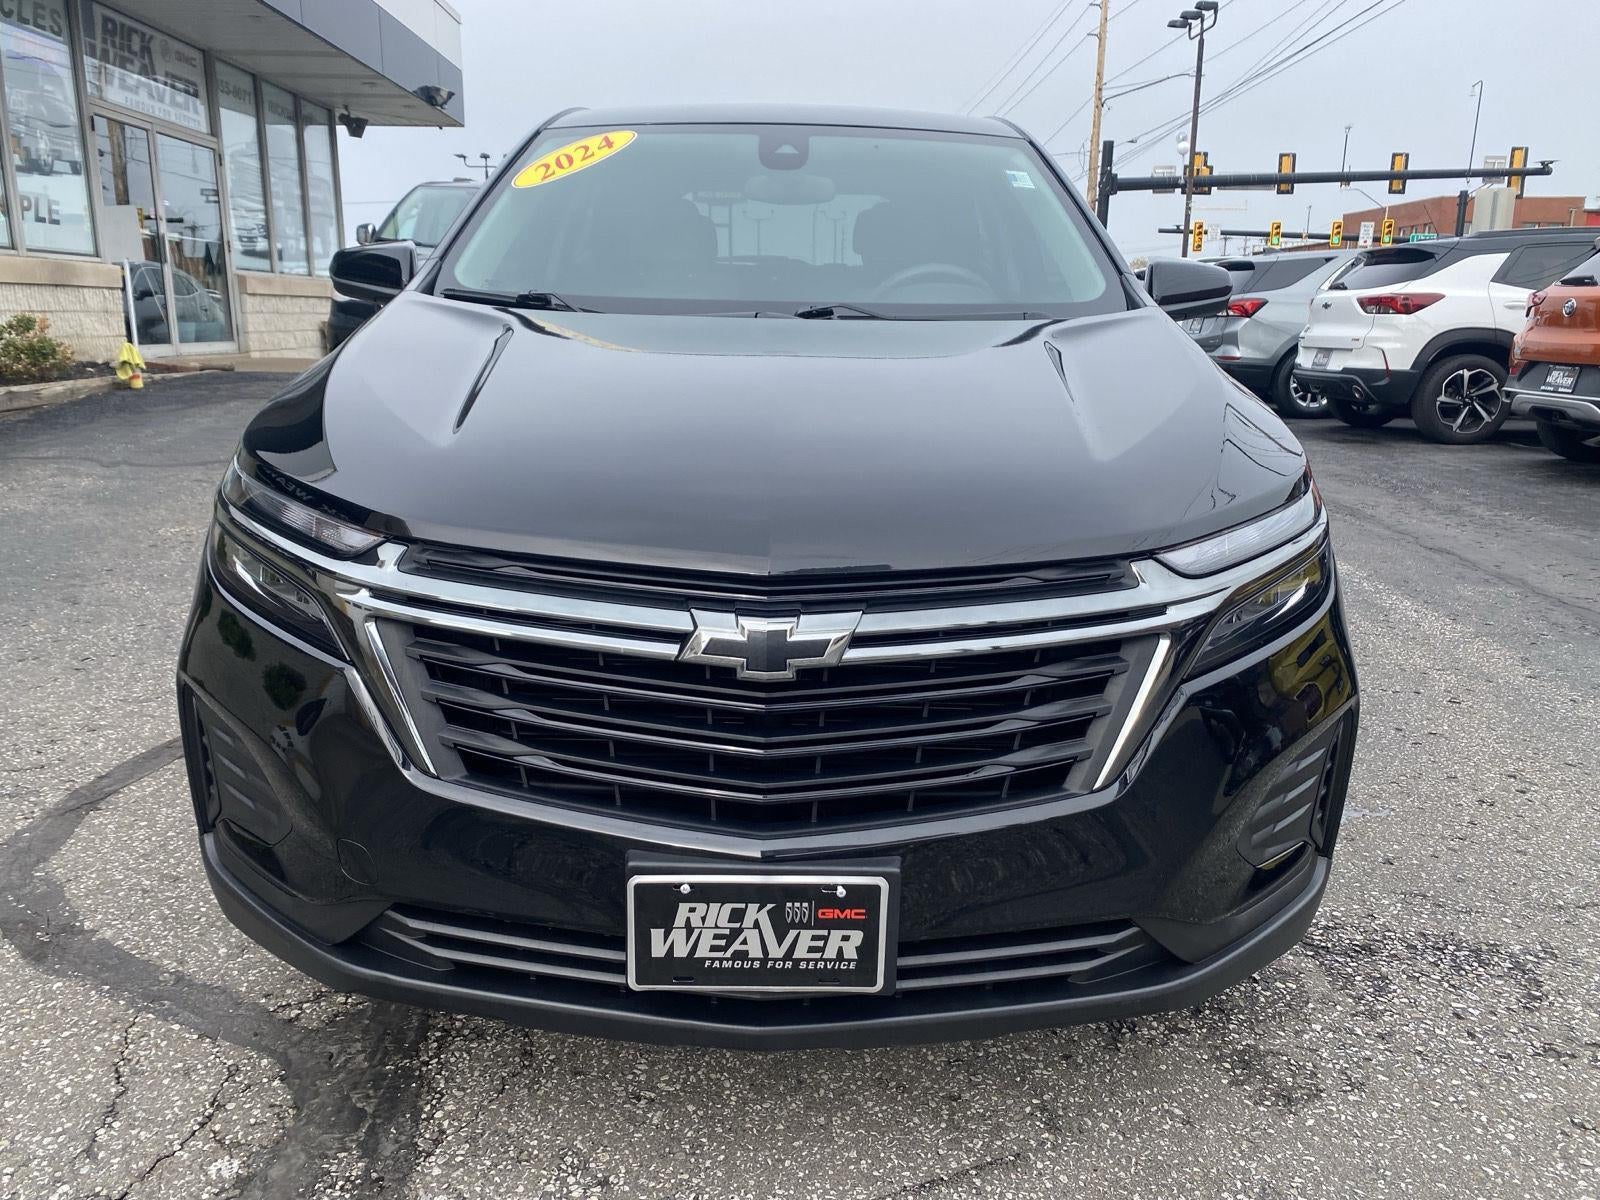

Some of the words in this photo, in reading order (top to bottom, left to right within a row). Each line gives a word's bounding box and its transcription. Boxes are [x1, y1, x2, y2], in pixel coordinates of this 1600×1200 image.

[101, 14, 155, 60] RICK
[534, 135, 615, 181] 2024
[672, 902, 777, 929] RICK
[817, 908, 867, 920] GMC
[650, 928, 864, 959] WEAVER
[704, 960, 761, 969] FAMOUS
[767, 960, 793, 969] FOR
[799, 961, 857, 970] SERVICE
